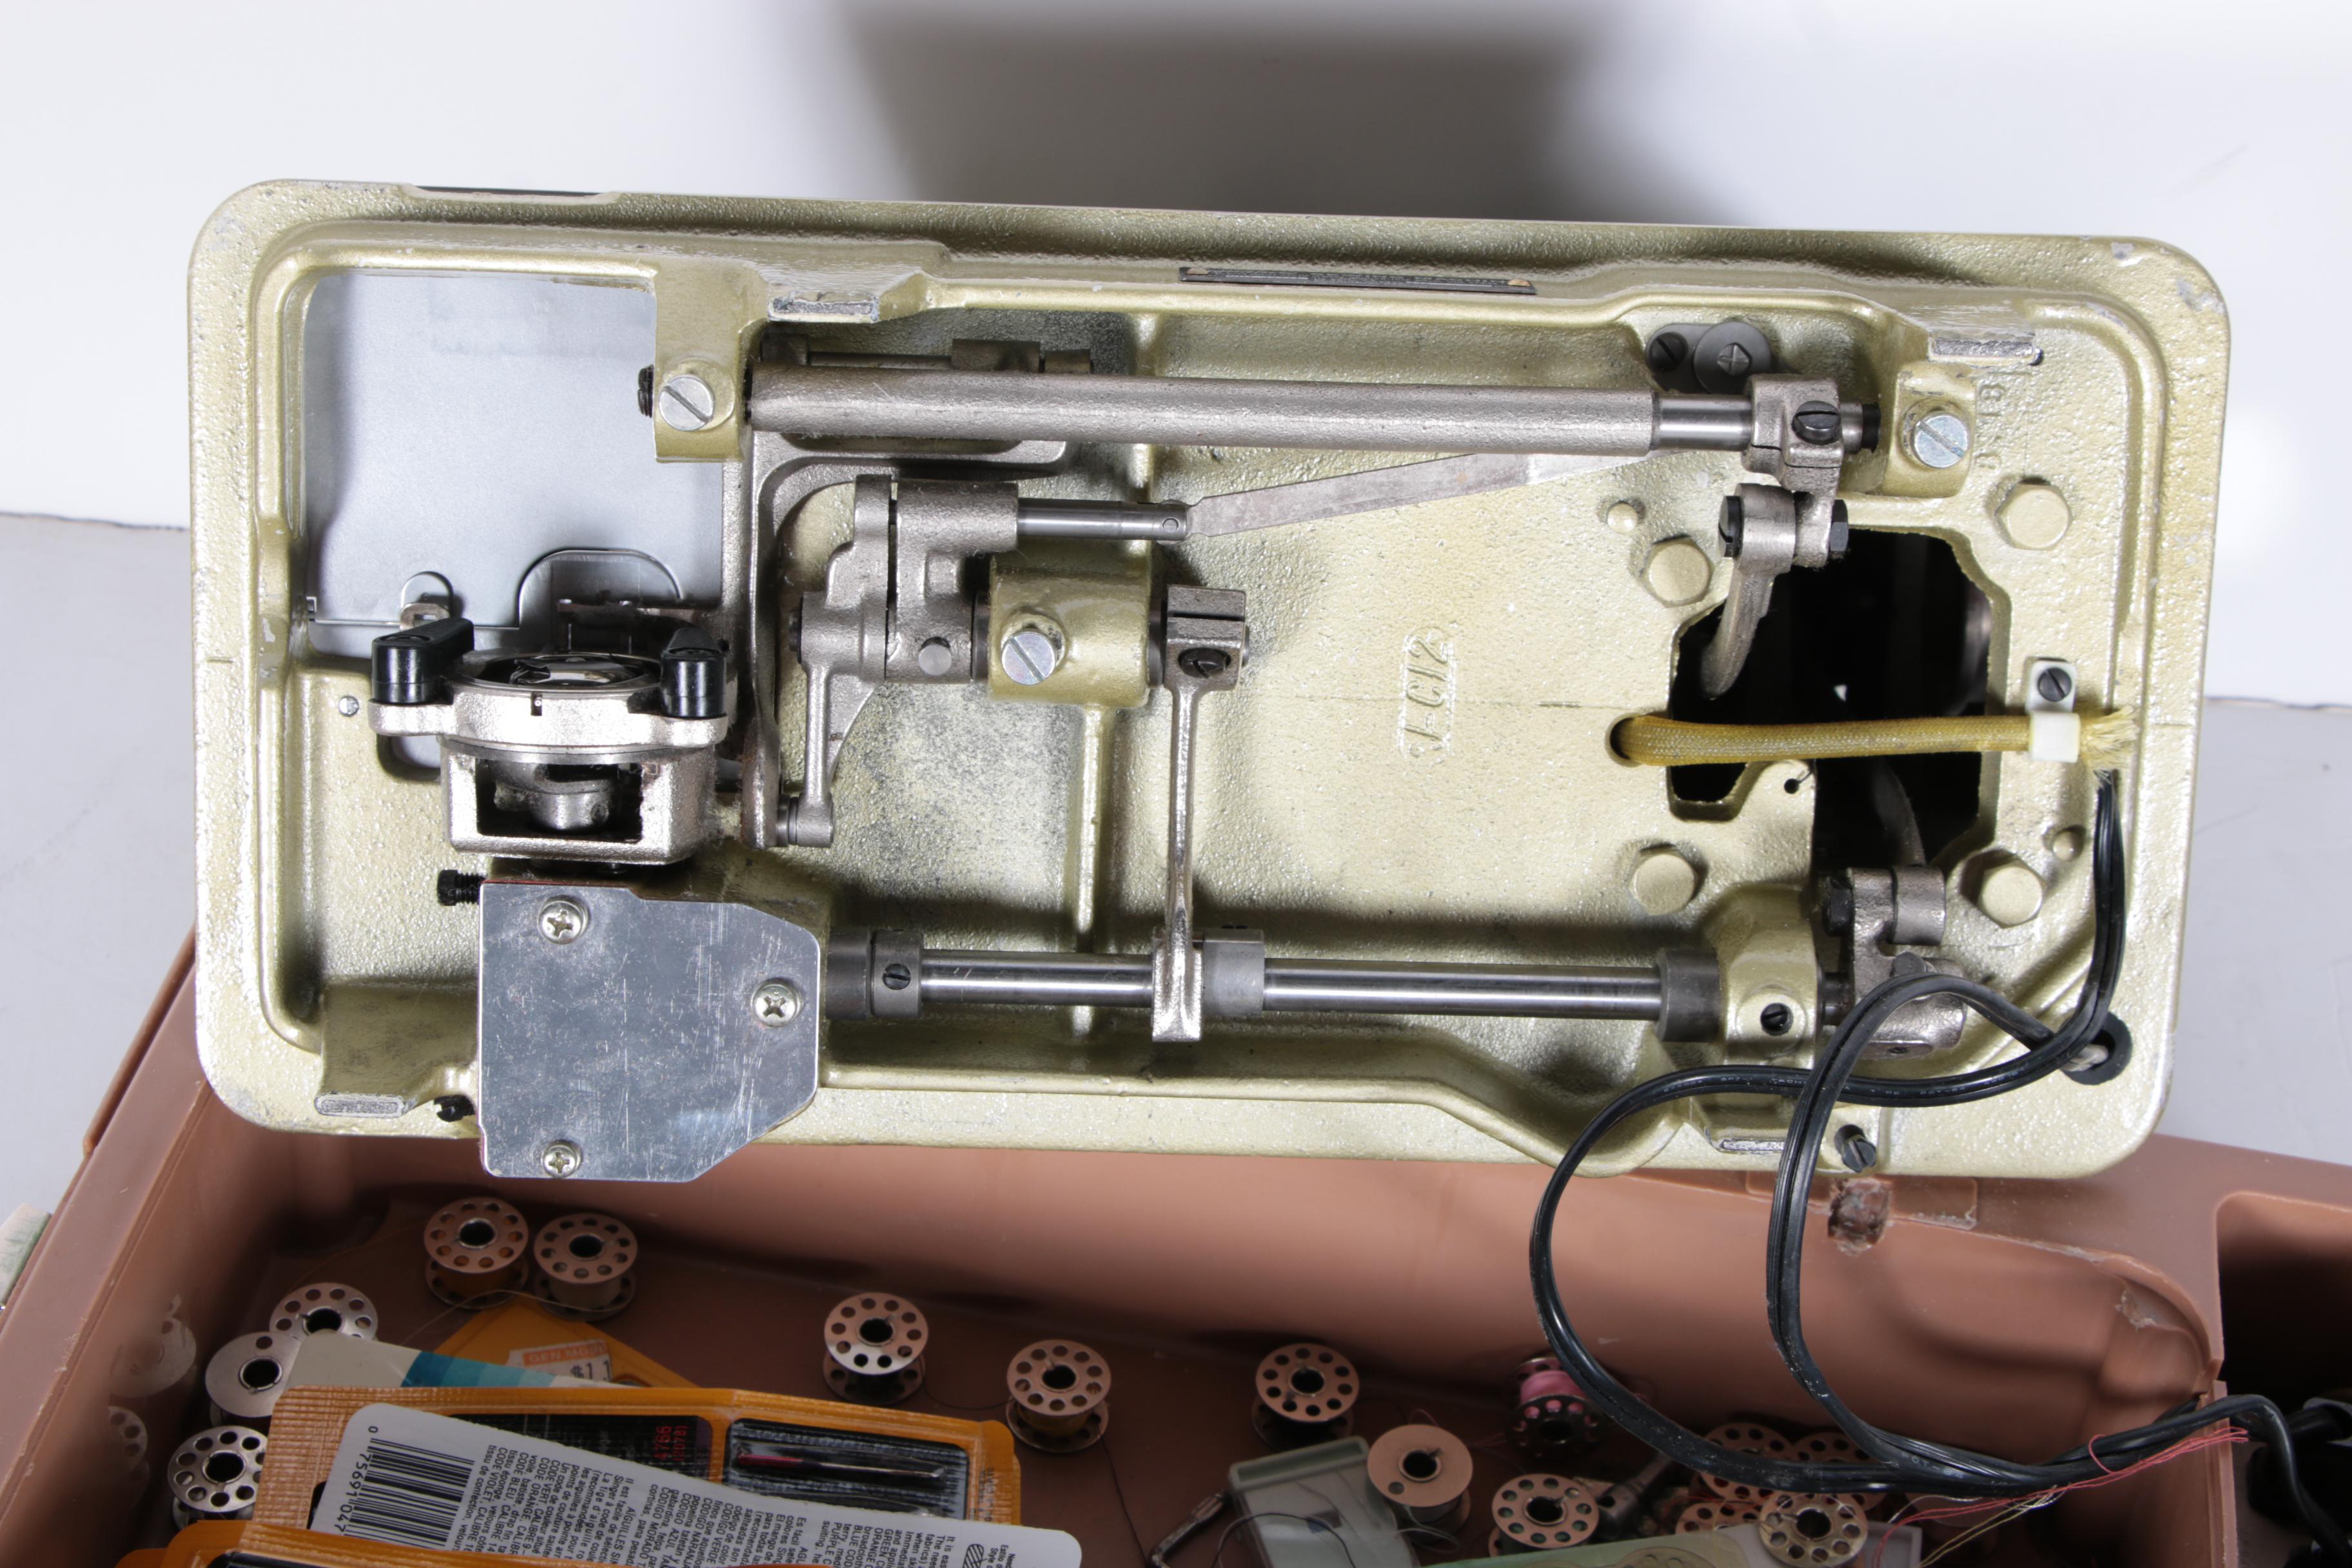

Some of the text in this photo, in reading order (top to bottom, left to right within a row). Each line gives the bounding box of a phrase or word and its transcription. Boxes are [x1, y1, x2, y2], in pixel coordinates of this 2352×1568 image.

[654, 1426, 672, 1460] 4766
[484, 1445, 497, 1464] tissu
[493, 1447, 508, 1470] CODE
[504, 1450, 518, 1469] tissu
[513, 1453, 529, 1475] CODE
[346, 1454, 371, 1496] 75691
[479, 1465, 489, 1476] de
[534, 1457, 550, 1480] CODE
[545, 1460, 560, 1482] CODE
[560, 1462, 571, 1474] Un
[566, 1465, 580, 1489] points
[581, 1467, 592, 1479] les
[602, 1473, 613, 1483] La
[480, 1472, 499, 1503] VIOLET,
[553, 1475, 565, 1493] code
[595, 1486, 608, 1502] tige
[609, 1475, 624, 1500] Singer
[620, 1486, 630, 1498] est
[520, 1483, 541, 1521] ORANGE,
[549, 1494, 558, 1504] de
[562, 1491, 571, 1500] de
[569, 1480, 585, 1512] aiguilles
[652, 1487, 671, 1519] CODIGO
[482, 1505, 497, 1533] velours
[507, 1510, 520, 1528] drap
[540, 1506, 554, 1534] couleur
[551, 1503, 567, 1533] couture
[598, 1509, 610, 1528] code
[612, 1500, 626, 1521] facile
[674, 1493, 692, 1525] CODIGO
[685, 1495, 700, 1527] popelina
[695, 1498, 713, 1529] CODIGO
[709, 1500, 723, 1519] finos
[467, 1507, 487, 1542] CALIBRE
[491, 1505, 511, 1540] CALIBRE
[525, 1508, 544, 1542] CALIBRE
[608, 1524, 618, 1534] de
[614, 1507, 635, 1550] AIGUILLES
[634, 1520, 646, 1538] pana
[704, 1521, 714, 1535] que
[763, 1513, 774, 1529] para
[780, 1516, 794, 1544] colores
[796, 1517, 807, 1527] Es
[558, 1520, 573, 1545] pointe
[594, 1530, 604, 1540] de
[640, 1522, 659, 1559] MORADO
[665, 1528, 680, 1549] AZUL
[707, 1503, 734, 1563] CODIGO VERDE
[725, 1533, 734, 1543] de
[730, 1509, 753, 1562] salteadas son
[756, 1532, 769, 1553] todas
[764, 1514, 786, 1561] El mango de
[825, 1522, 843, 1555] PURPLE
[879, 1529, 894, 1557] GREEN
[893, 1530, 902, 1545] and
[912, 1533, 923, 1554] when
[934, 1536, 946, 1550] The
[567, 1535, 579, 1554] pour
[718, 1545, 730, 1565] color
[843, 1525, 863, 1568] BLUE COD
[867, 1527, 883, 1562] ORANGE
[988, 1548, 999, 1563] Style
[997, 1545, 1008, 1562] Estilo
